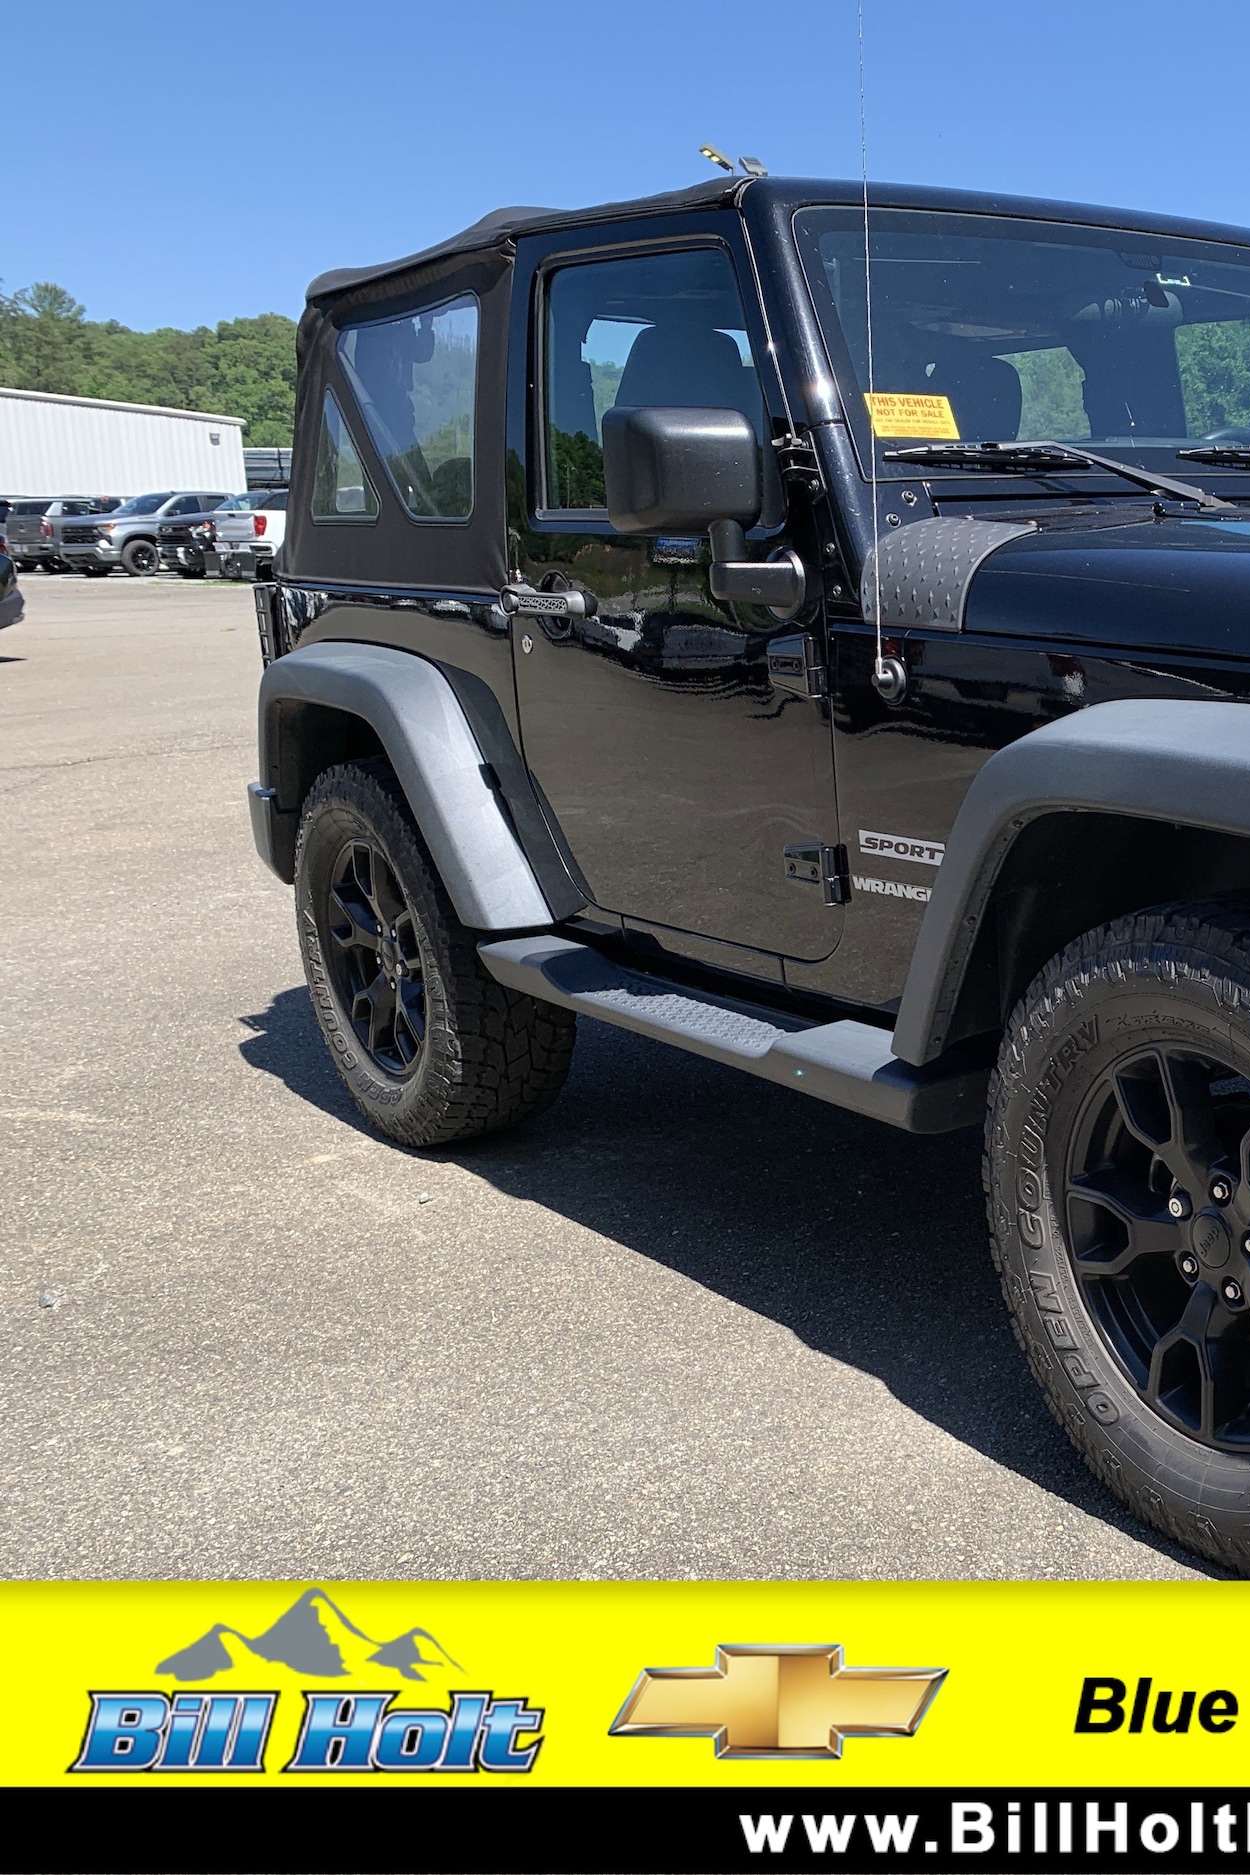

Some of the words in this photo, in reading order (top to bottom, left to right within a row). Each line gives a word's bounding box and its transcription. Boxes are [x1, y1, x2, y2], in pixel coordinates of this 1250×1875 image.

[871, 396, 897, 407] THIS
[897, 397, 944, 409] VEHICLE
[876, 408, 895, 417] NOT
[899, 409, 918, 417] FOR
[922, 409, 945, 419] SALE
[860, 836, 945, 860] SPORT
[303, 909, 359, 1070] COUNTRY
[357, 1070, 402, 1105] OPEN
[1016, 1014, 1101, 1250] COUNTRY
[1199, 1226, 1220, 1258] Jeep
[1029, 1270, 1120, 1427] OPEN
